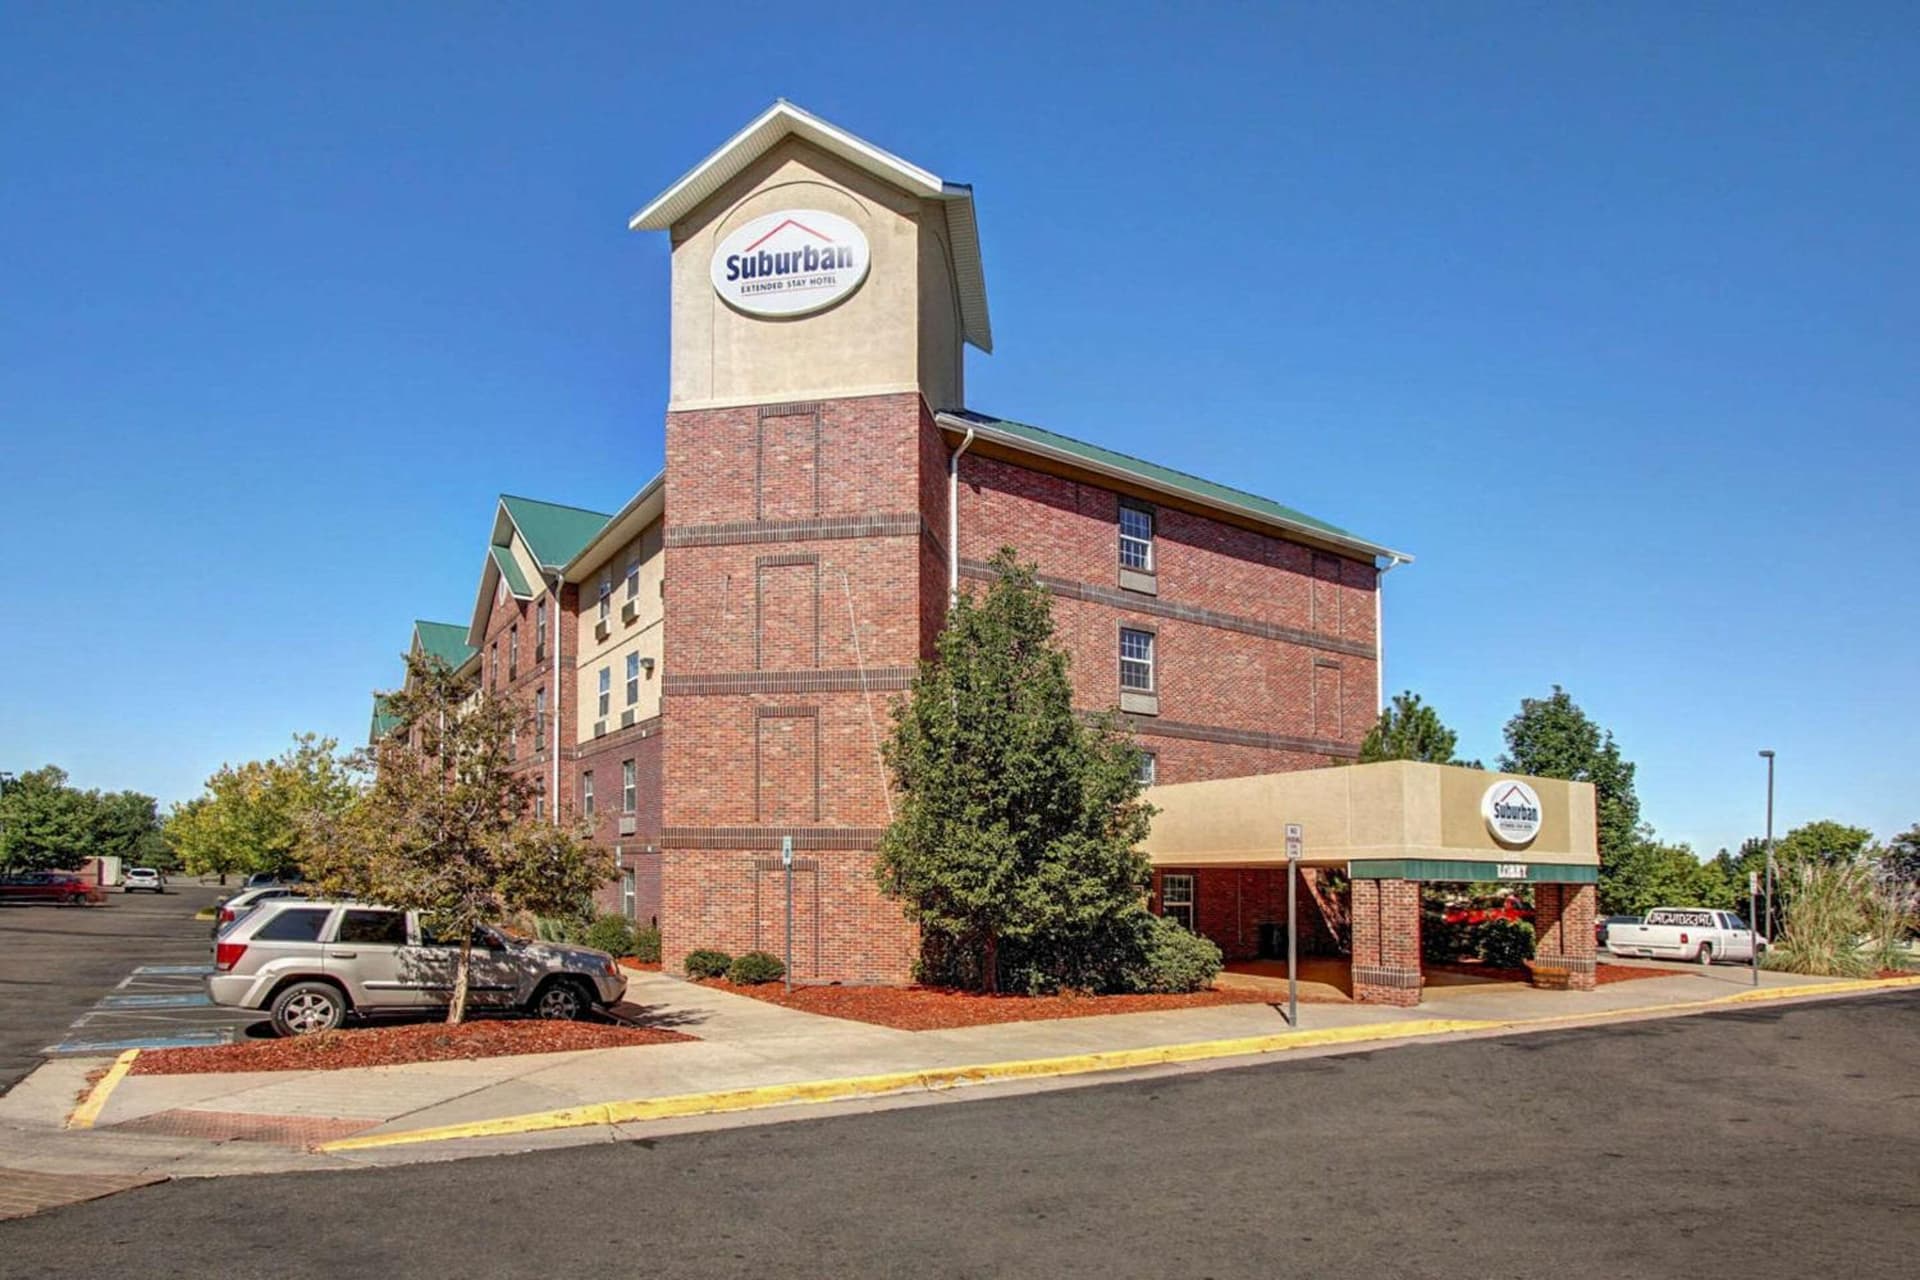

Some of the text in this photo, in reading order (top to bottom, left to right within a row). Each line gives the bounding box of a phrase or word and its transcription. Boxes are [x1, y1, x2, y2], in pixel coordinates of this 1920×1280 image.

[726, 245, 853, 282] Suburban
[741, 276, 836, 294] EXTENDED STAY HOTEL
[1494, 802, 1538, 821] Suburban
